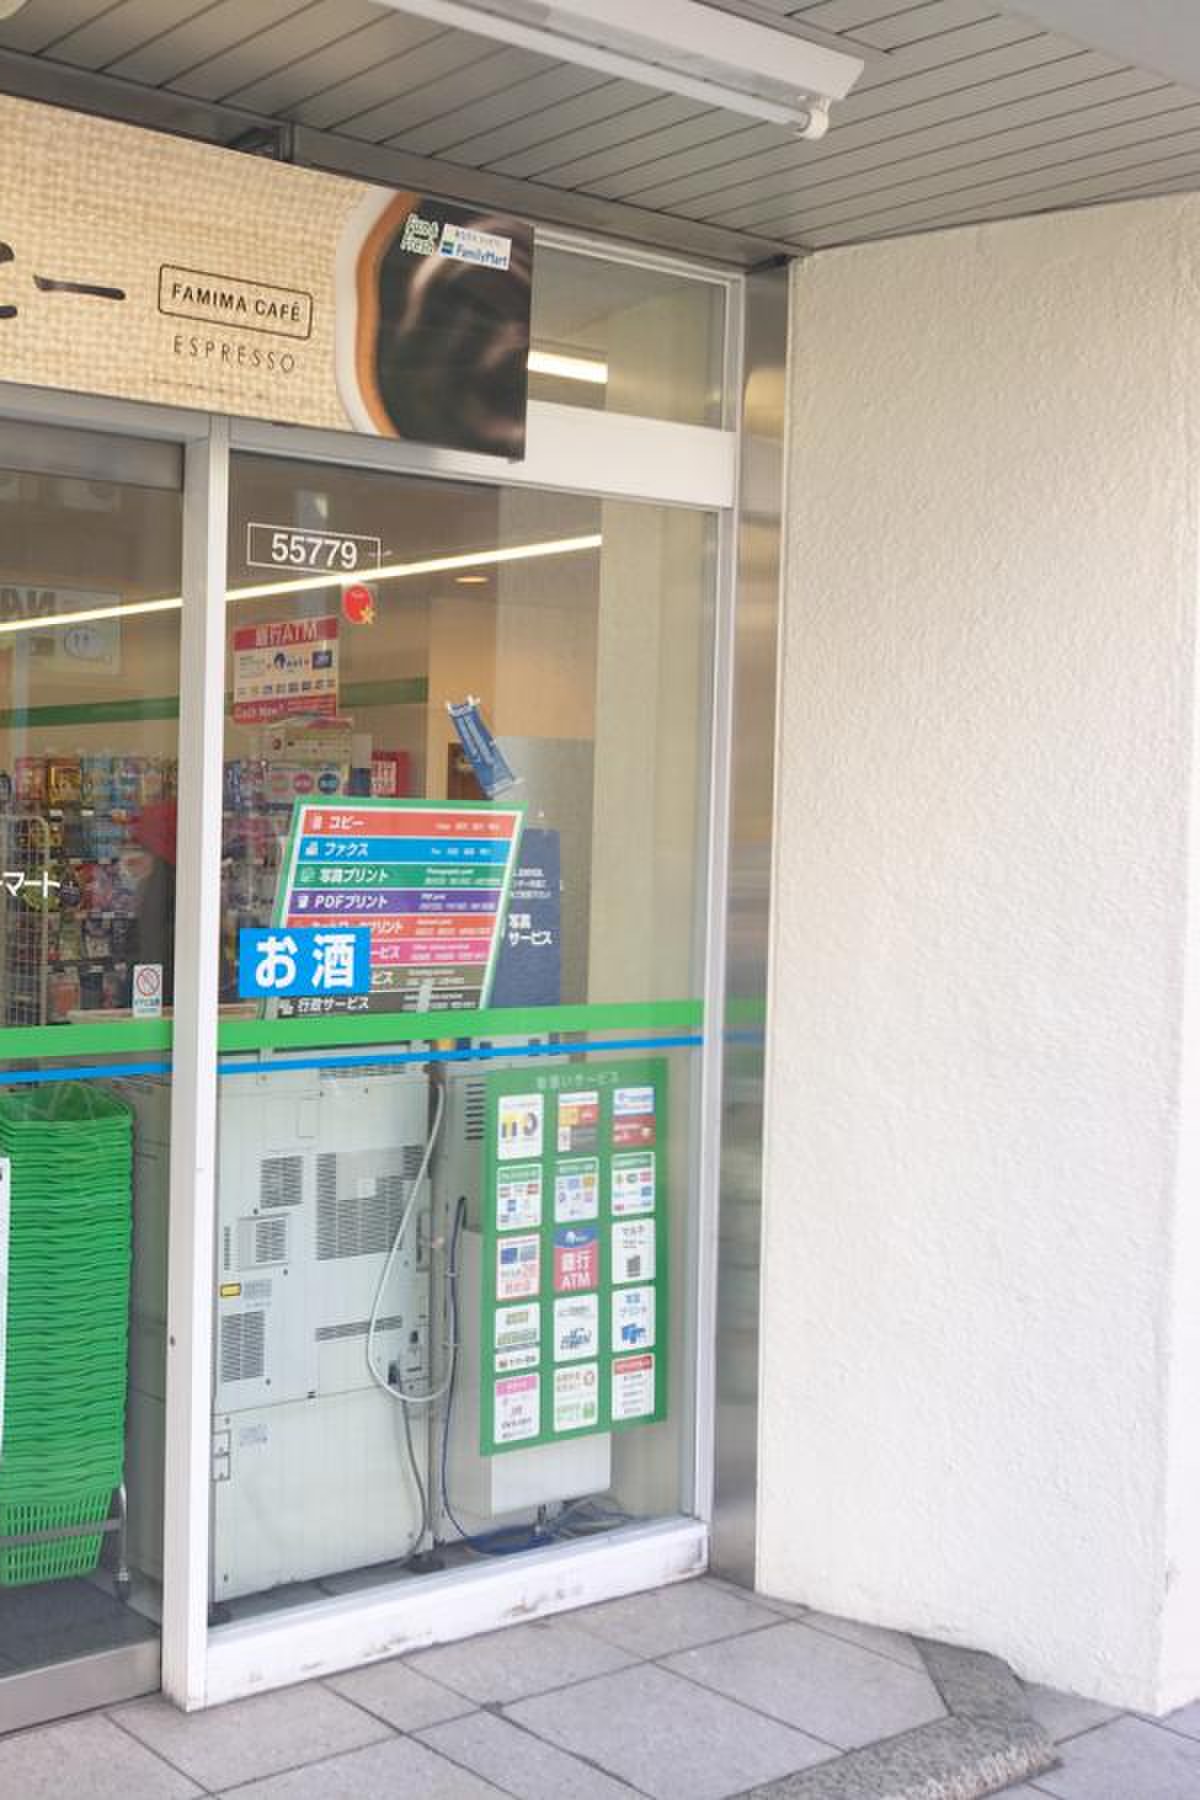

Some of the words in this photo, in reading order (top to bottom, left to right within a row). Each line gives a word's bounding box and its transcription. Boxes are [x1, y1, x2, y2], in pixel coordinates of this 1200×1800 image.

[170, 281, 249, 316] FAMIMA
[253, 298, 302, 323] CAFÉ
[173, 335, 297, 375] ESPRESSO
[271, 534, 358, 570] 55779
[329, 815, 365, 831] コピー
[314, 895, 389, 910] PDFプリント
[508, 930, 553, 947] サービス
[253, 934, 357, 990] お酒
[560, 1271, 593, 1290] ATM
